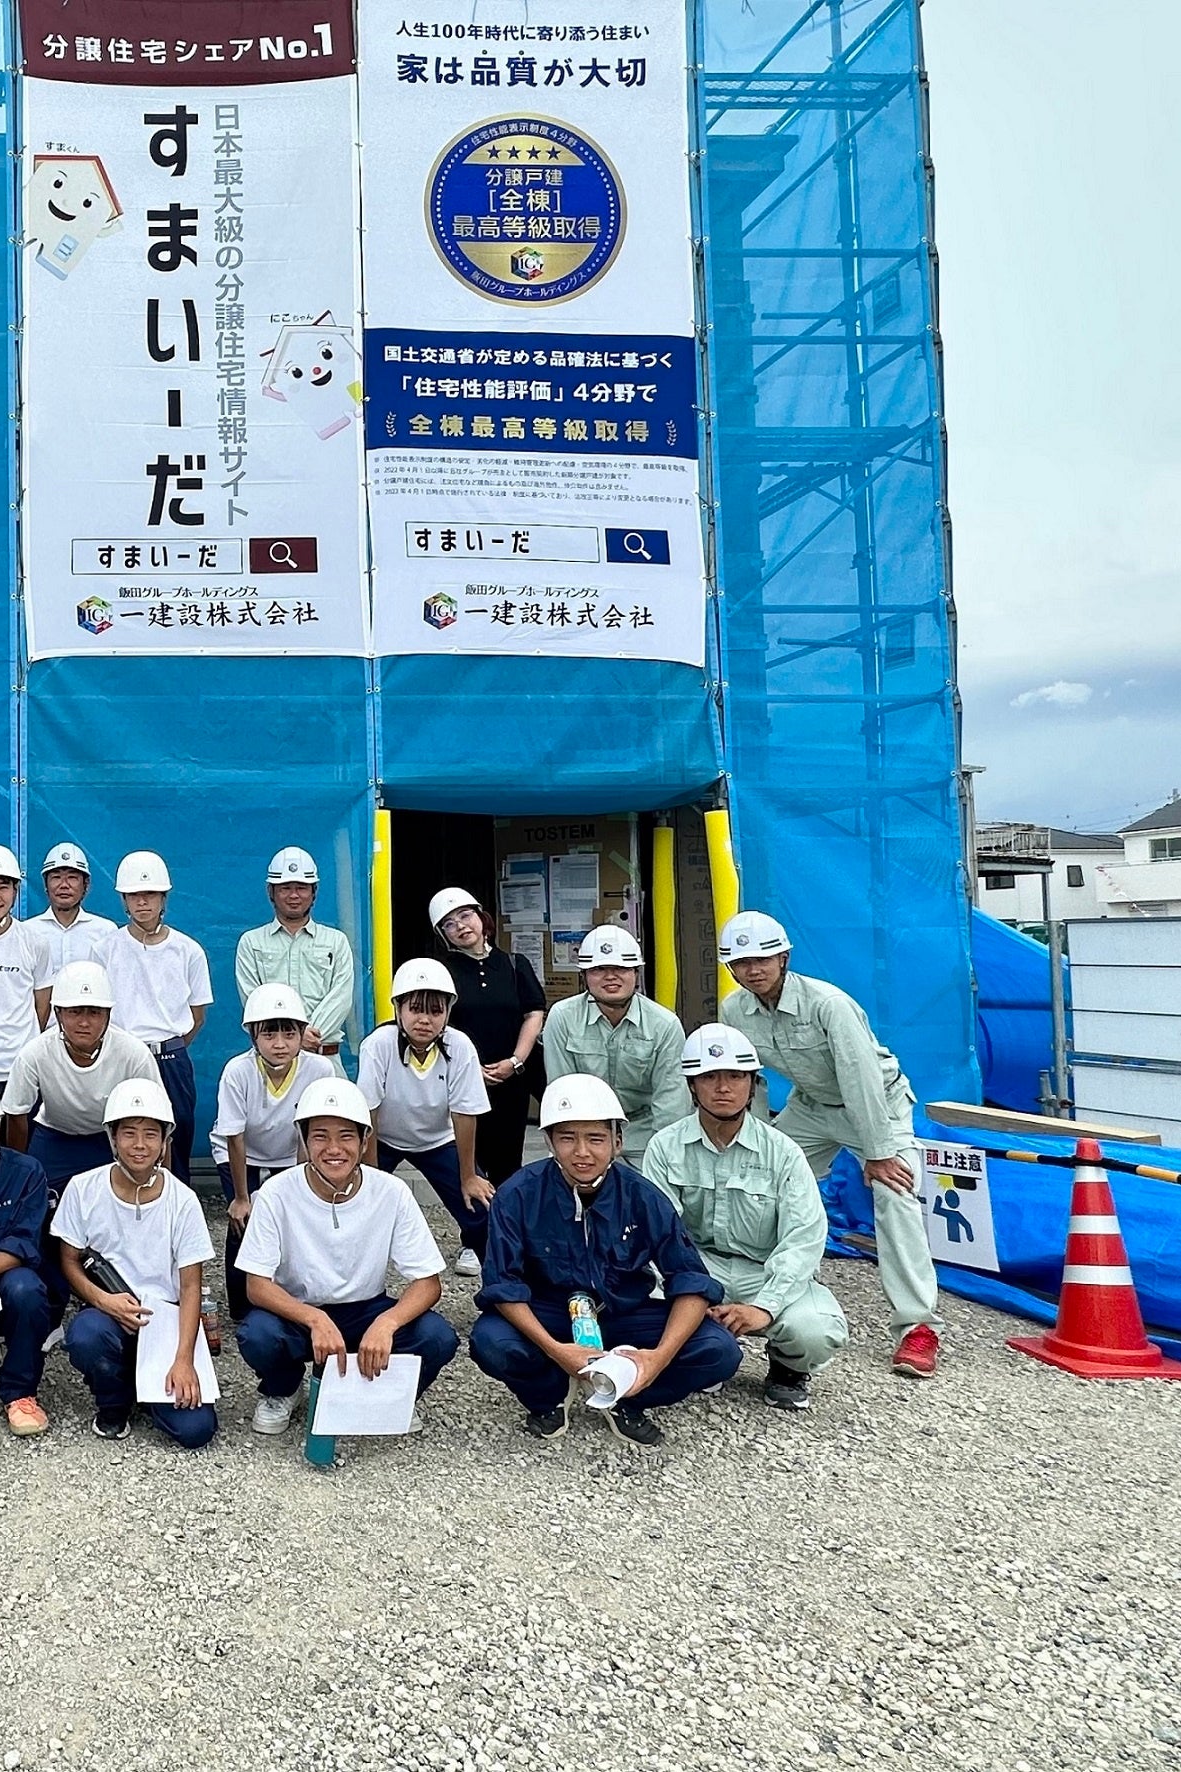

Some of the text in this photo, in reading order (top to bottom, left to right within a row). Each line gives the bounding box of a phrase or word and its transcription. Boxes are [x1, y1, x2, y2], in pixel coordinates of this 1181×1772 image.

[43, 23, 332, 64] 分譲住宅シェアNo.1
[396, 21, 650, 41] 人生100年時代に寄り添う住まい
[397, 53, 646, 87] 家は品質が大切
[485, 168, 564, 187] 分譲戸建
[452, 215, 602, 240] 最高等級取得
[144, 105, 206, 526] すまいーだ
[213, 104, 249, 526] 日本最大級の分譲住宅情報サイト
[384, 345, 672, 369] 国土交通省が定める品確法に基づく
[402, 376, 658, 404] 「住宅性能評価」4分野で
[408, 413, 650, 443] 全棟最高等級取得
[415, 528, 530, 554] すまいーだ
[98, 545, 218, 568] すまいーだ
[118, 586, 259, 599] 飯田グループホールディングス
[465, 583, 600, 599] 飯田グループホールディングス
[120, 600, 320, 628] 一建設株式会社
[464, 600, 655, 629] 一建設株式会社
[524, 823, 596, 843] TOSTEM
[925, 1148, 983, 1172] 頭上注意
